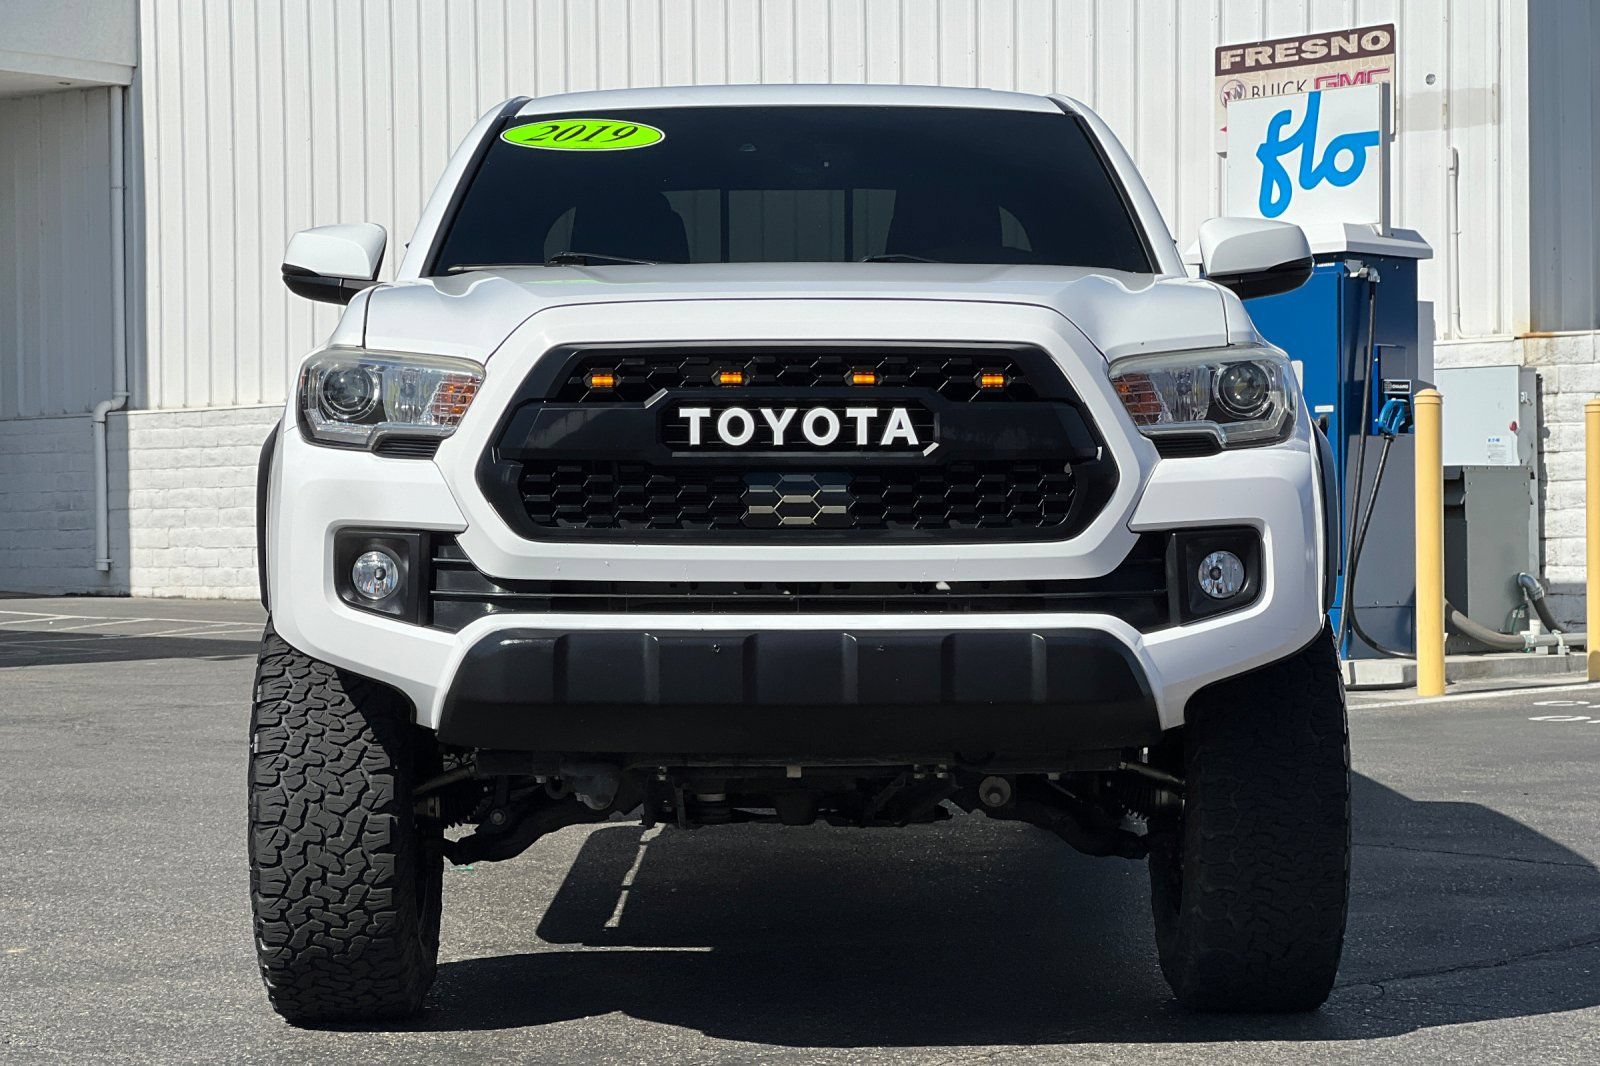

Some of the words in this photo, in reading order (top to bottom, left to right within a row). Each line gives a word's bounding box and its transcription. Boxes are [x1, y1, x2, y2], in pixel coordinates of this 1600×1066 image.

[1220, 30, 1391, 70] FRESNO
[525, 124, 639, 143] 2019
[1256, 91, 1380, 218] flo
[679, 407, 919, 446] TOYOTA
